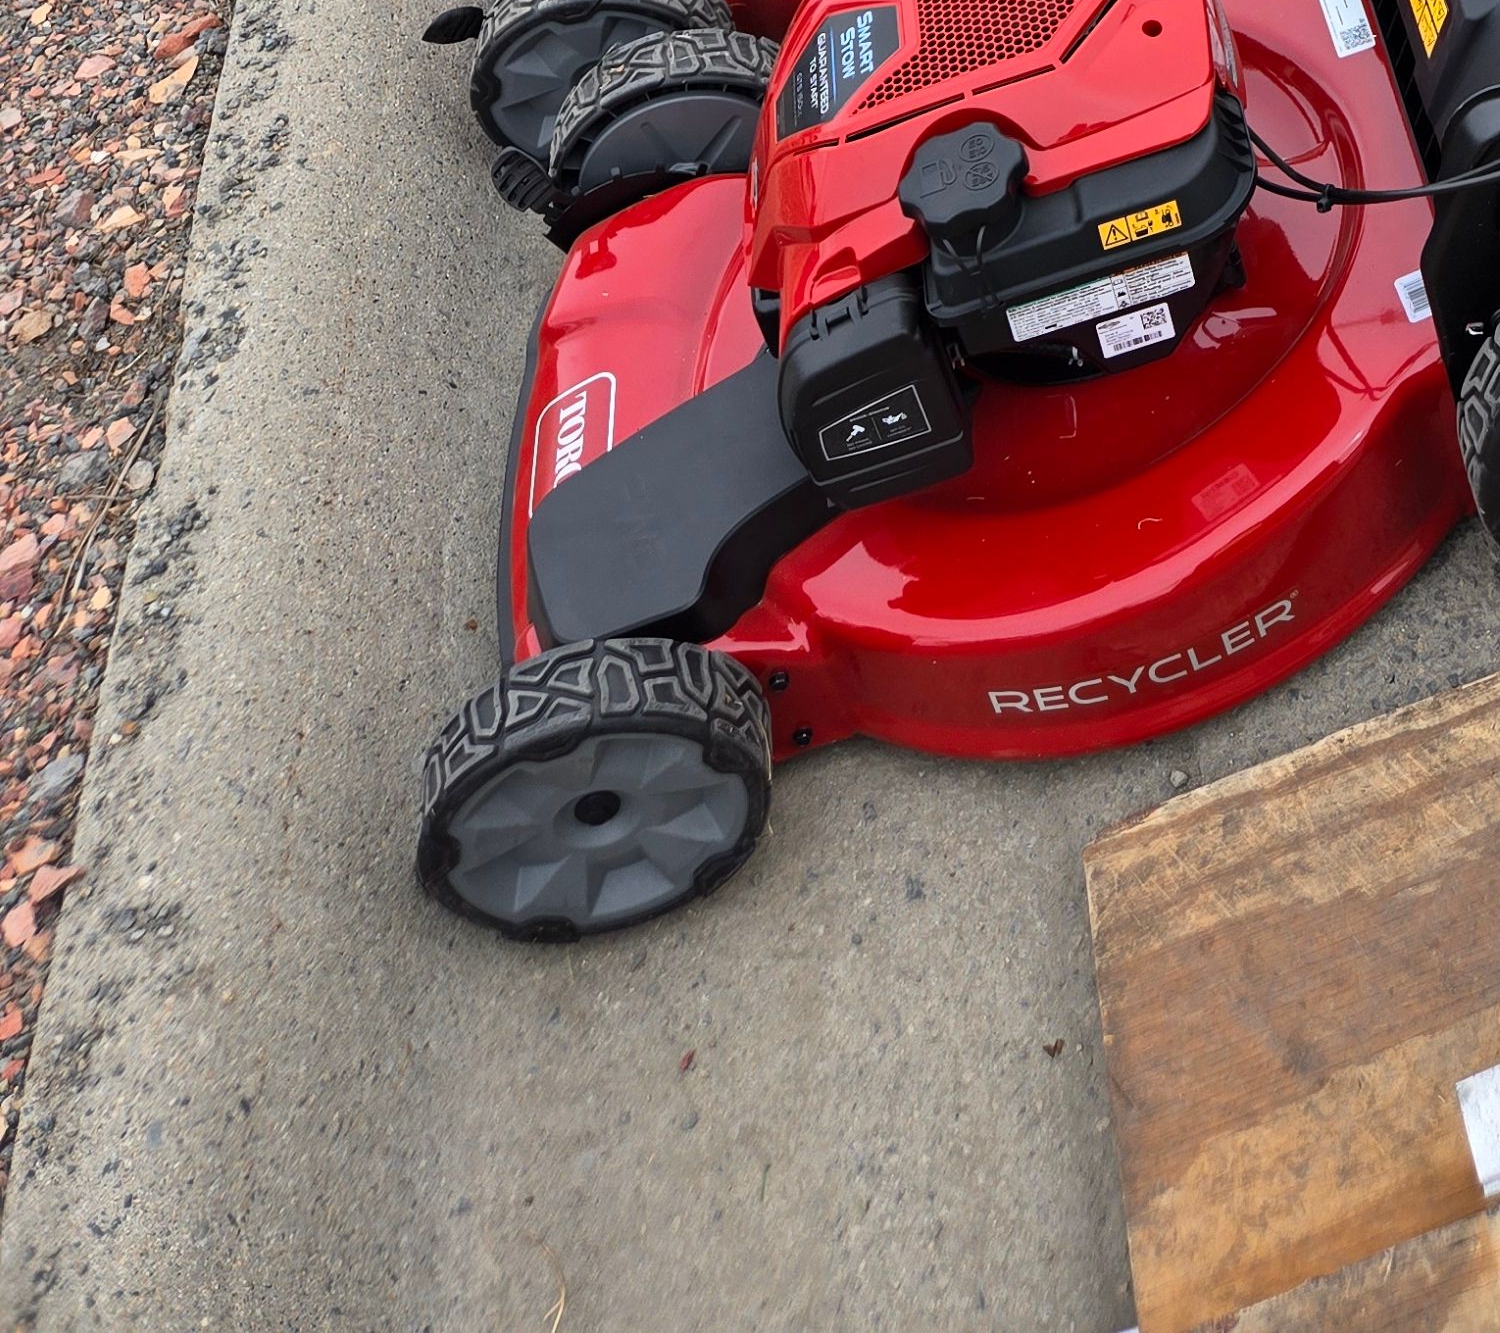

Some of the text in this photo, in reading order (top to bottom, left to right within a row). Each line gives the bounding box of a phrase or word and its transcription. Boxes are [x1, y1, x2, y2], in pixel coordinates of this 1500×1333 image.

[817, 32, 829, 114] GUARANTEED
[840, 26, 856, 79] STOW
[856, 10, 875, 74] SMART
[809, 56, 819, 110] TO START
[987, 598, 1296, 714] RECYCLER
